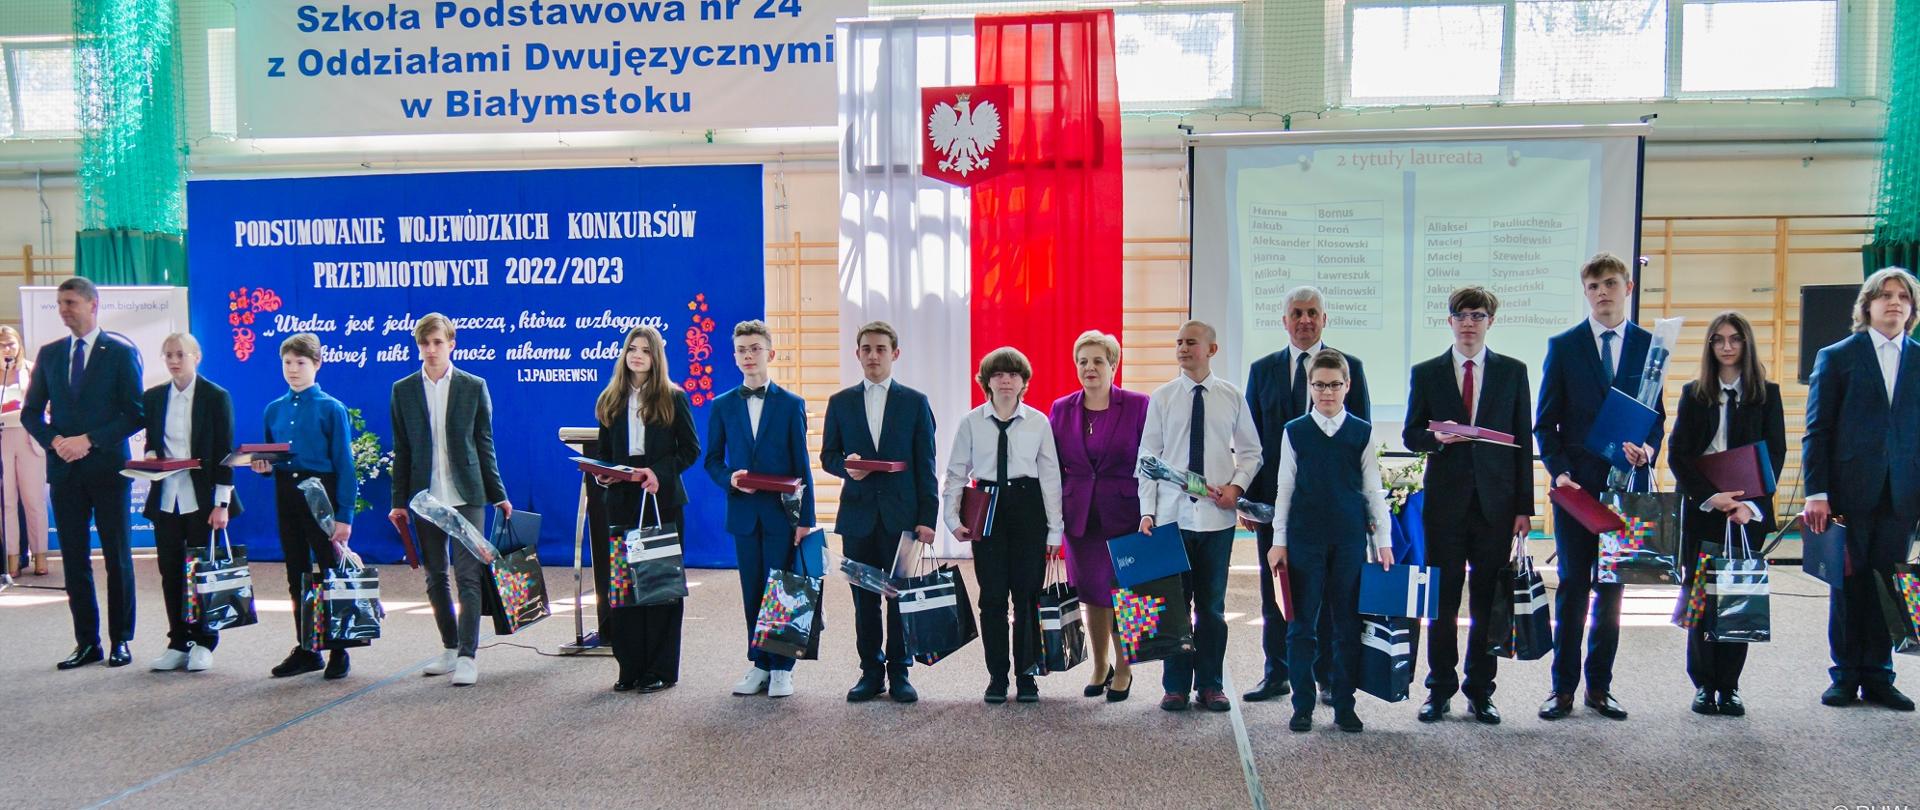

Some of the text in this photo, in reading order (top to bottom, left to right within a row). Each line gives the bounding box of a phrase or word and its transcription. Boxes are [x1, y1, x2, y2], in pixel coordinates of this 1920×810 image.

[296, 0, 802, 33] Szkoła Podstawowa nr 24
[267, 34, 835, 77] z Oddziałami Dwujęzycznymi
[400, 86, 691, 123] w Białymstoku
[1336, 148, 1483, 170] 2 tytuły laureata
[1253, 206, 1287, 217] Hanna
[235, 204, 696, 247] PODSUMOWANIE WOJEWÓDZKICH KONKURSÓW
[1253, 221, 1283, 231] Jakub
[1252, 236, 1311, 248] Aleksander
[1427, 234, 1552, 248] Maciej Sobolewski
[1253, 252, 1366, 264] Hanna Kononiuk
[1427, 252, 1463, 263] Maciej
[313, 257, 624, 288] PRZEDMIOTOWYCH 2022/2023
[1254, 267, 1291, 280] Mikołaj
[1427, 267, 1549, 280] Oliwia Szymaszko
[1254, 284, 1285, 296] Dawid
[345, 315, 375, 336] jest
[382, 313, 419, 336] jedy
[519, 310, 565, 329] która
[576, 309, 668, 333] wzbogaca,
[1328, 315, 1368, 328] yśliwiec
[321, 344, 367, 368] której
[376, 344, 410, 361] nikt
[453, 345, 496, 360] może
[506, 341, 571, 360] nikomu
[517, 369, 598, 382] I.J.PADEREWSKI
